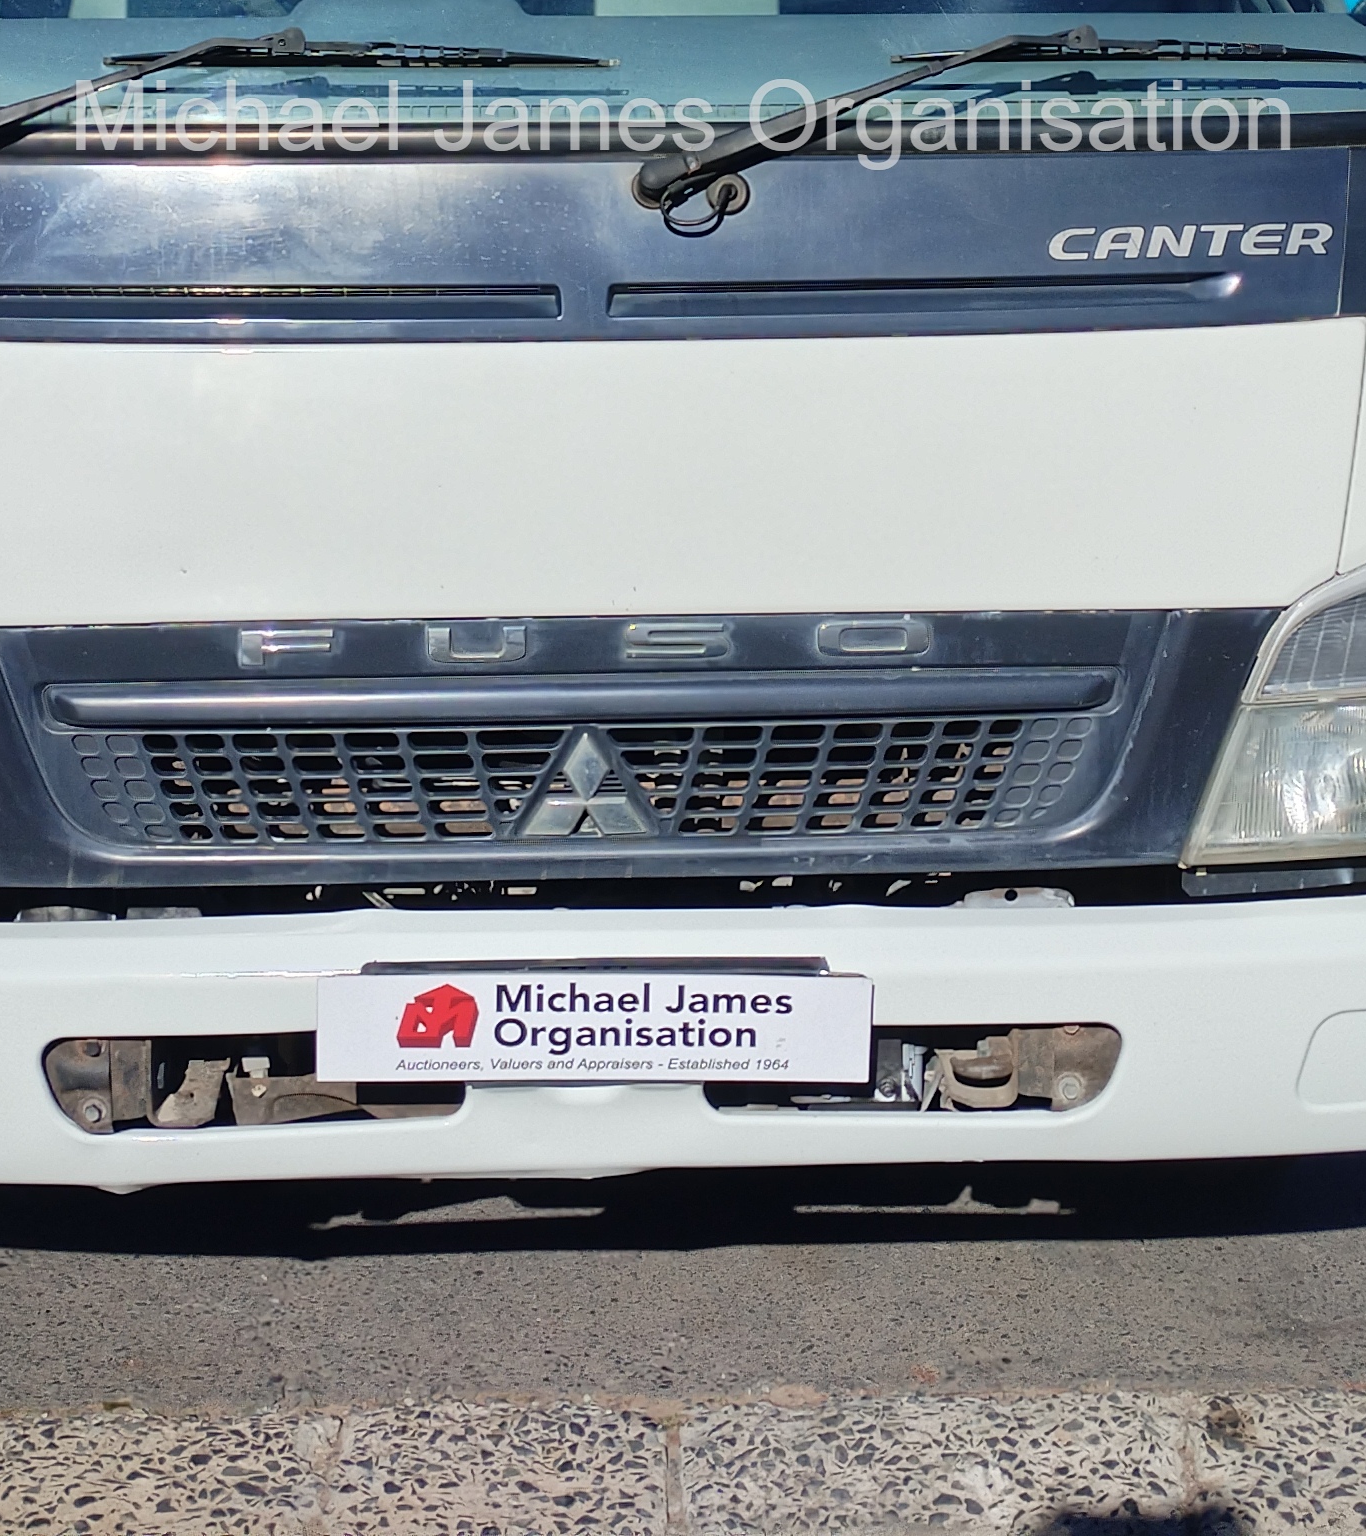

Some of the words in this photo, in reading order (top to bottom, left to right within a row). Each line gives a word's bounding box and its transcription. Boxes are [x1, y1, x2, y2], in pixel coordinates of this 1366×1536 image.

[1047, 221, 1334, 262] CANTER
[239, 619, 932, 667] FUSO
[495, 982, 651, 1013] Michael
[665, 984, 793, 1014] James
[494, 1017, 757, 1056] Organisation
[396, 1059, 484, 1072] Auctioneers,
[490, 1058, 543, 1070] Valuers
[547, 1058, 574, 1070] and
[576, 1058, 653, 1073] Appraisers
[667, 1058, 750, 1071] Established
[756, 1059, 790, 1071] 1964
